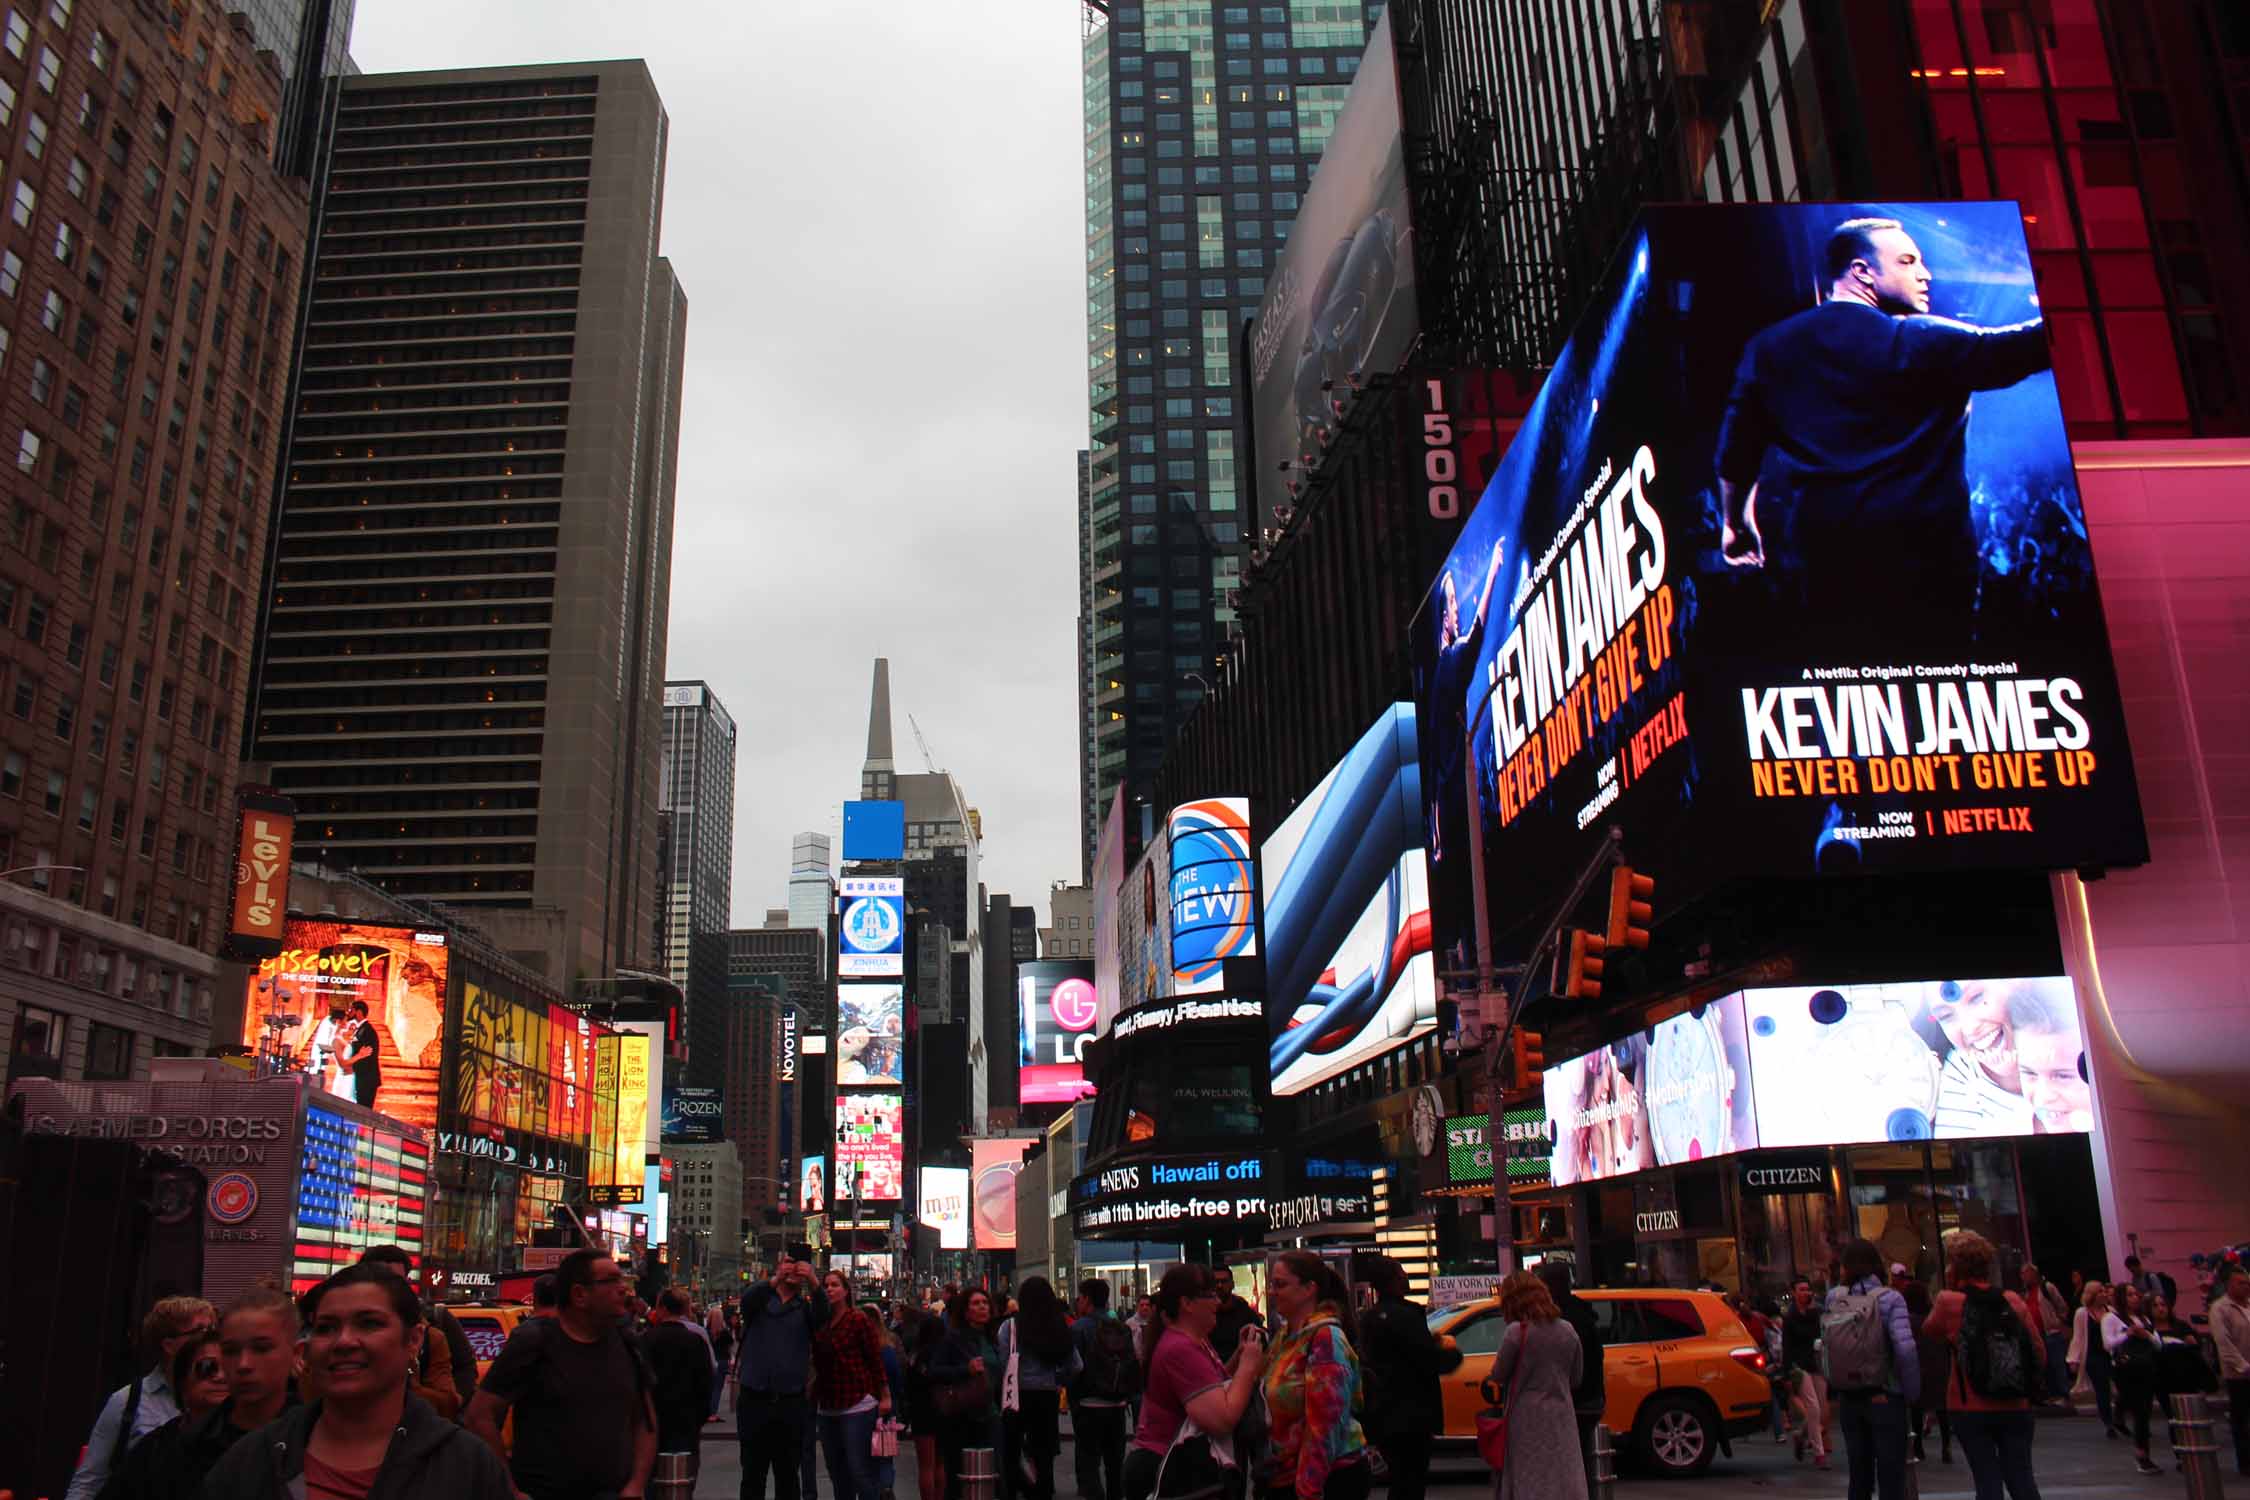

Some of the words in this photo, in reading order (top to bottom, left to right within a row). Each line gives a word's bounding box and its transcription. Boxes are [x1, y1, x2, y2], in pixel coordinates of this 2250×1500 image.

[1423, 379, 1459, 520] 1500
[1533, 543, 1559, 585] Original
[1558, 503, 1586, 552] Comedy
[1584, 457, 1612, 510] Special
[1488, 579, 1563, 770] KEVIN
[1560, 445, 1666, 683] JAMES
[1803, 669, 1813, 680] A
[1815, 666, 1860, 680] Netflix
[1861, 665, 1913, 681] Original
[1915, 664, 1968, 679] Comedy
[1970, 662, 2018, 676] Special
[1499, 747, 1547, 829] NEVER
[1545, 673, 1594, 779] DON'T
[1597, 620, 1643, 724] GIVE
[1643, 584, 1675, 672] UP
[1742, 684, 1910, 760] KEVIN
[1914, 677, 2091, 755] JAMES
[1630, 691, 1690, 780] NETFLIX
[1597, 756, 1617, 788] NOW
[1752, 758, 1860, 797] NEVER
[1868, 754, 1962, 793] DON'T
[1972, 752, 2048, 790] GIVE
[2054, 750, 2097, 786] UP
[1576, 779, 1620, 831] STREAMING
[1878, 812, 1914, 825] NOW
[1942, 807, 2034, 835] NETFLIX
[1832, 824, 1917, 841] STREAMING
[1177, 867, 1198, 884] THE
[782, 1012, 795, 1081] NOVOTEL
[64, 1116, 168, 1138] ARMED
[174, 1116, 281, 1139] FORCES
[1106, 1166, 1140, 1192] NEWS
[1152, 1162, 1220, 1185] Hawaii
[1226, 1160, 1262, 1181] offi
[1747, 1167, 1823, 1186] CITIZEN
[1112, 1202, 1133, 1223] 11th
[1135, 1197, 1230, 1222] birdie-free
[1269, 1194, 1321, 1231] SEPHORA
[1636, 1209, 1680, 1233] CITIZEN
[450, 1271, 496, 1287] SKECHER
[1433, 1277, 1456, 1290] NEW
[1457, 1277, 1483, 1289] YORK
